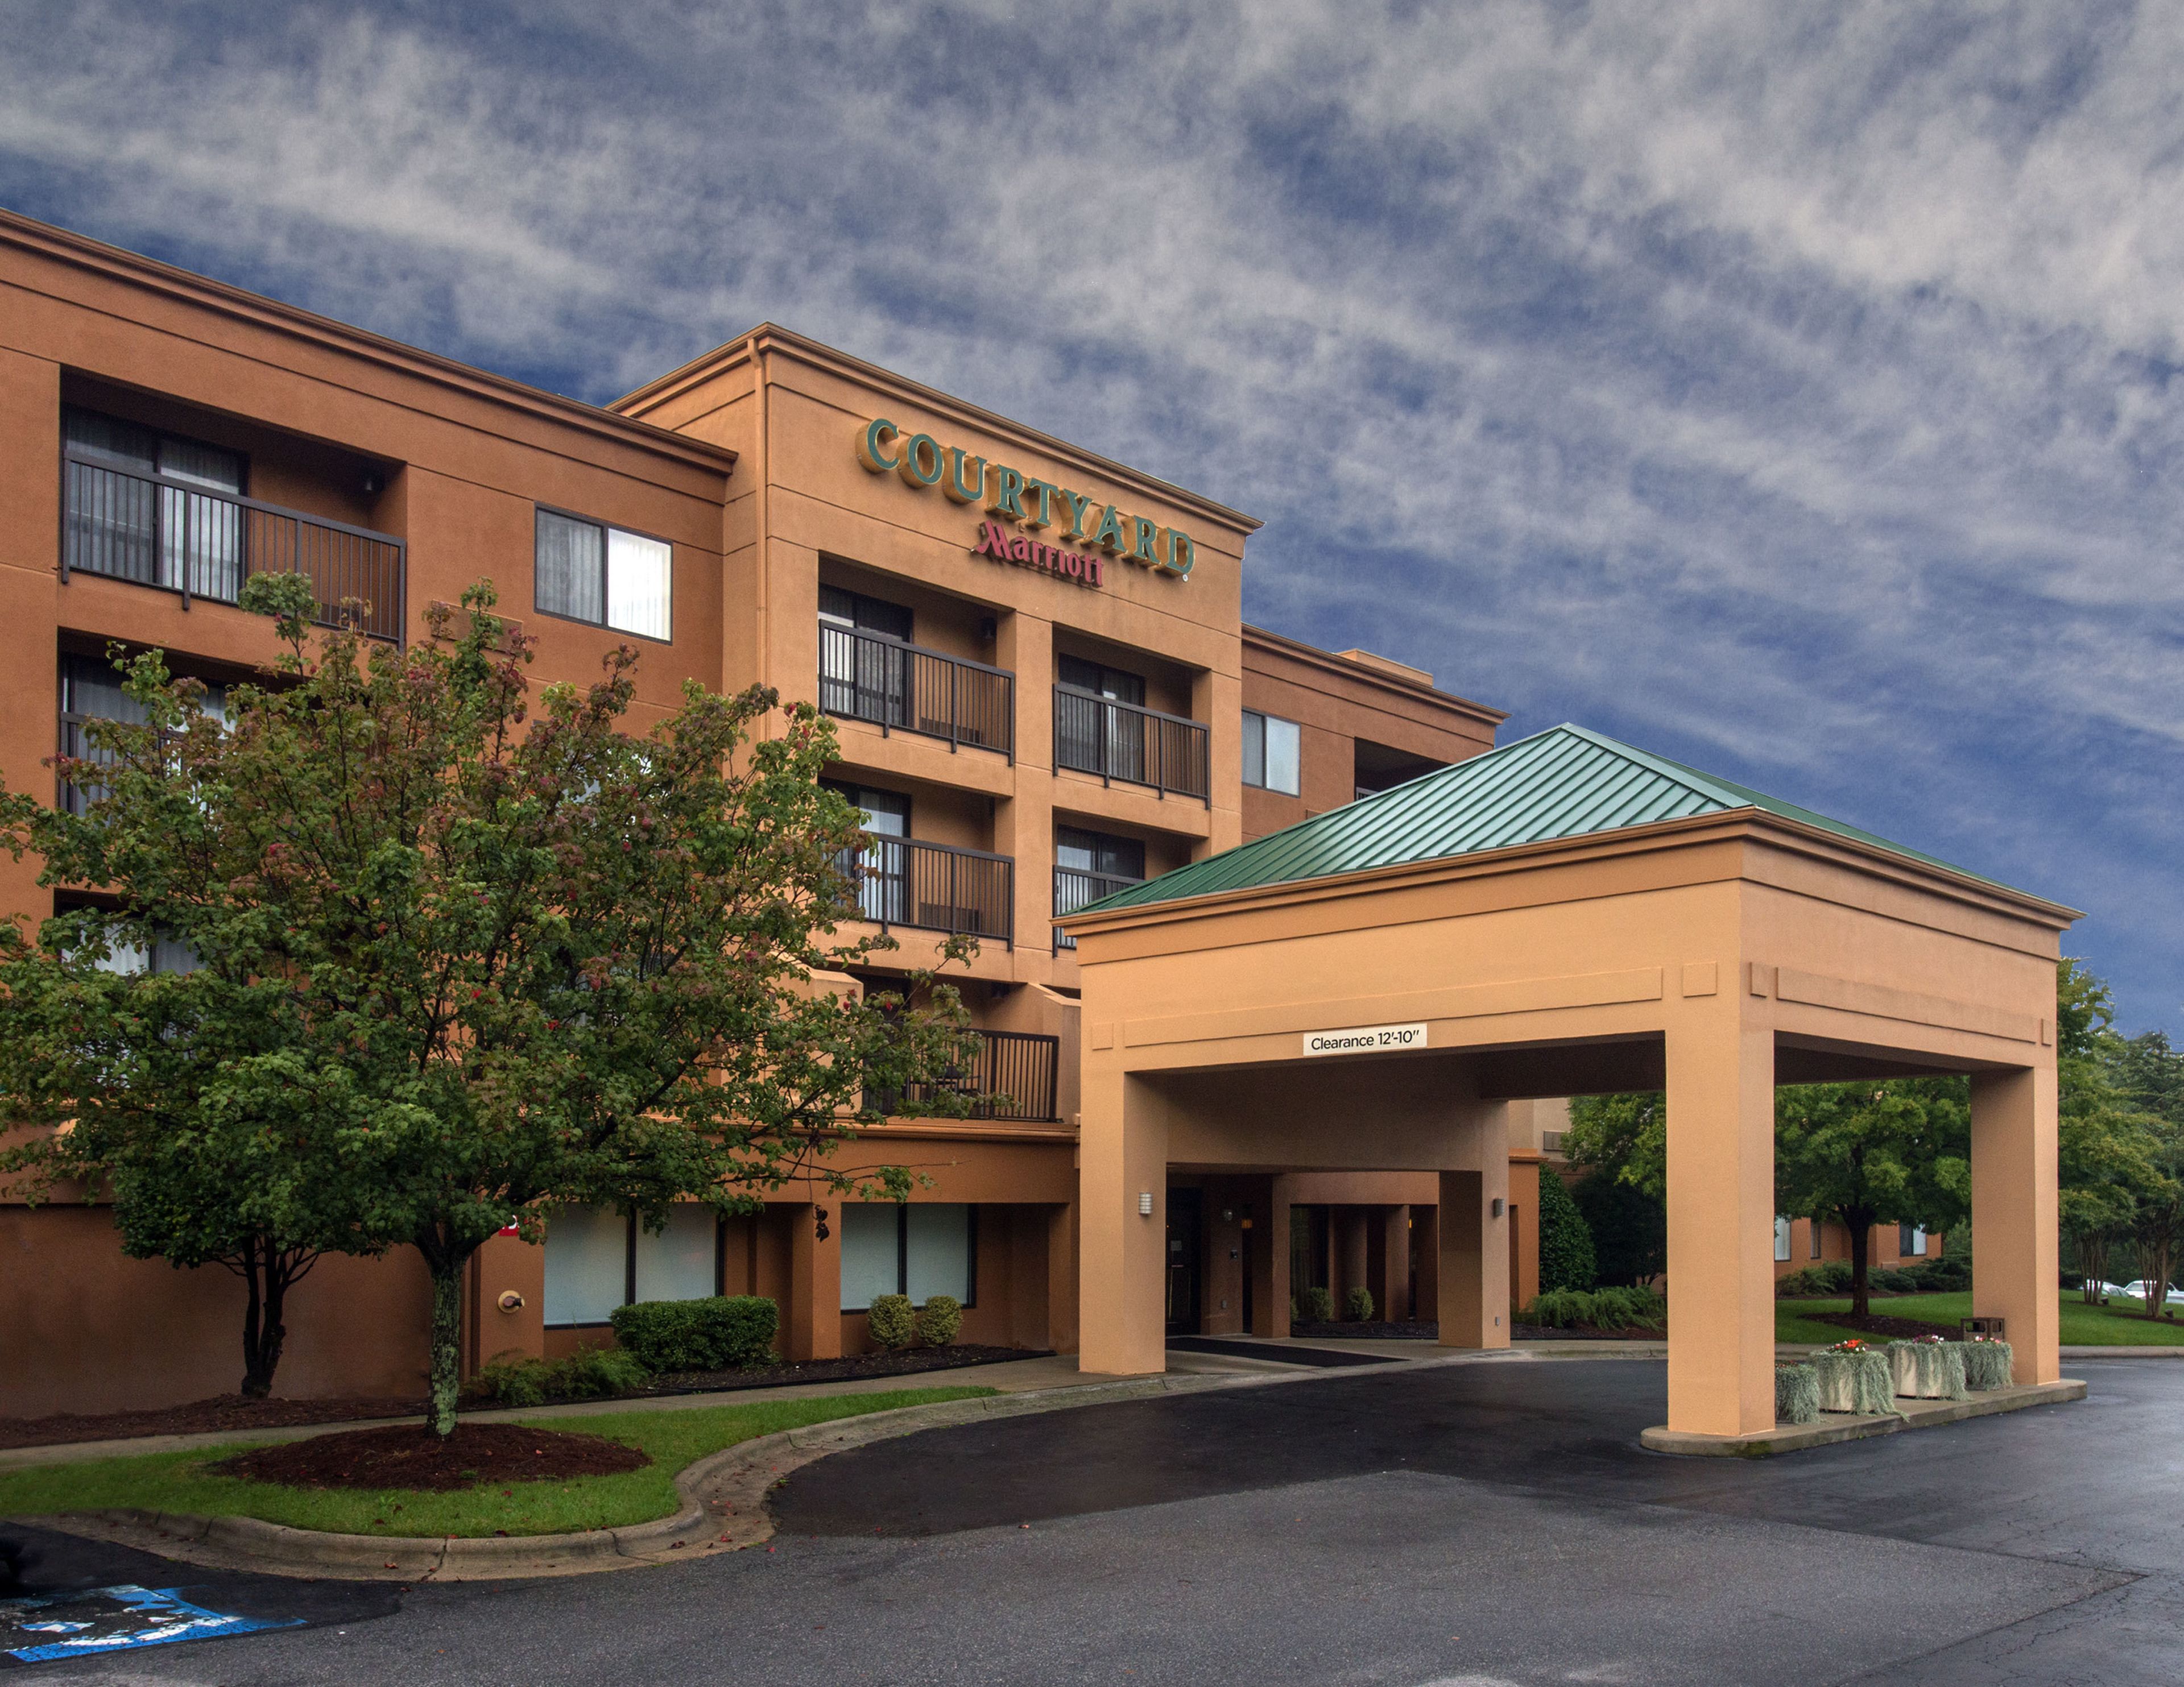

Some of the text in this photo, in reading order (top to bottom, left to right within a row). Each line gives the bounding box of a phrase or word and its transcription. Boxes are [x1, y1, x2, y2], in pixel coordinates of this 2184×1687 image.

[862, 418, 1196, 574] COURTYARD
[975, 519, 1103, 587] Marriott
[1310, 1035, 1375, 1051] Clearance
